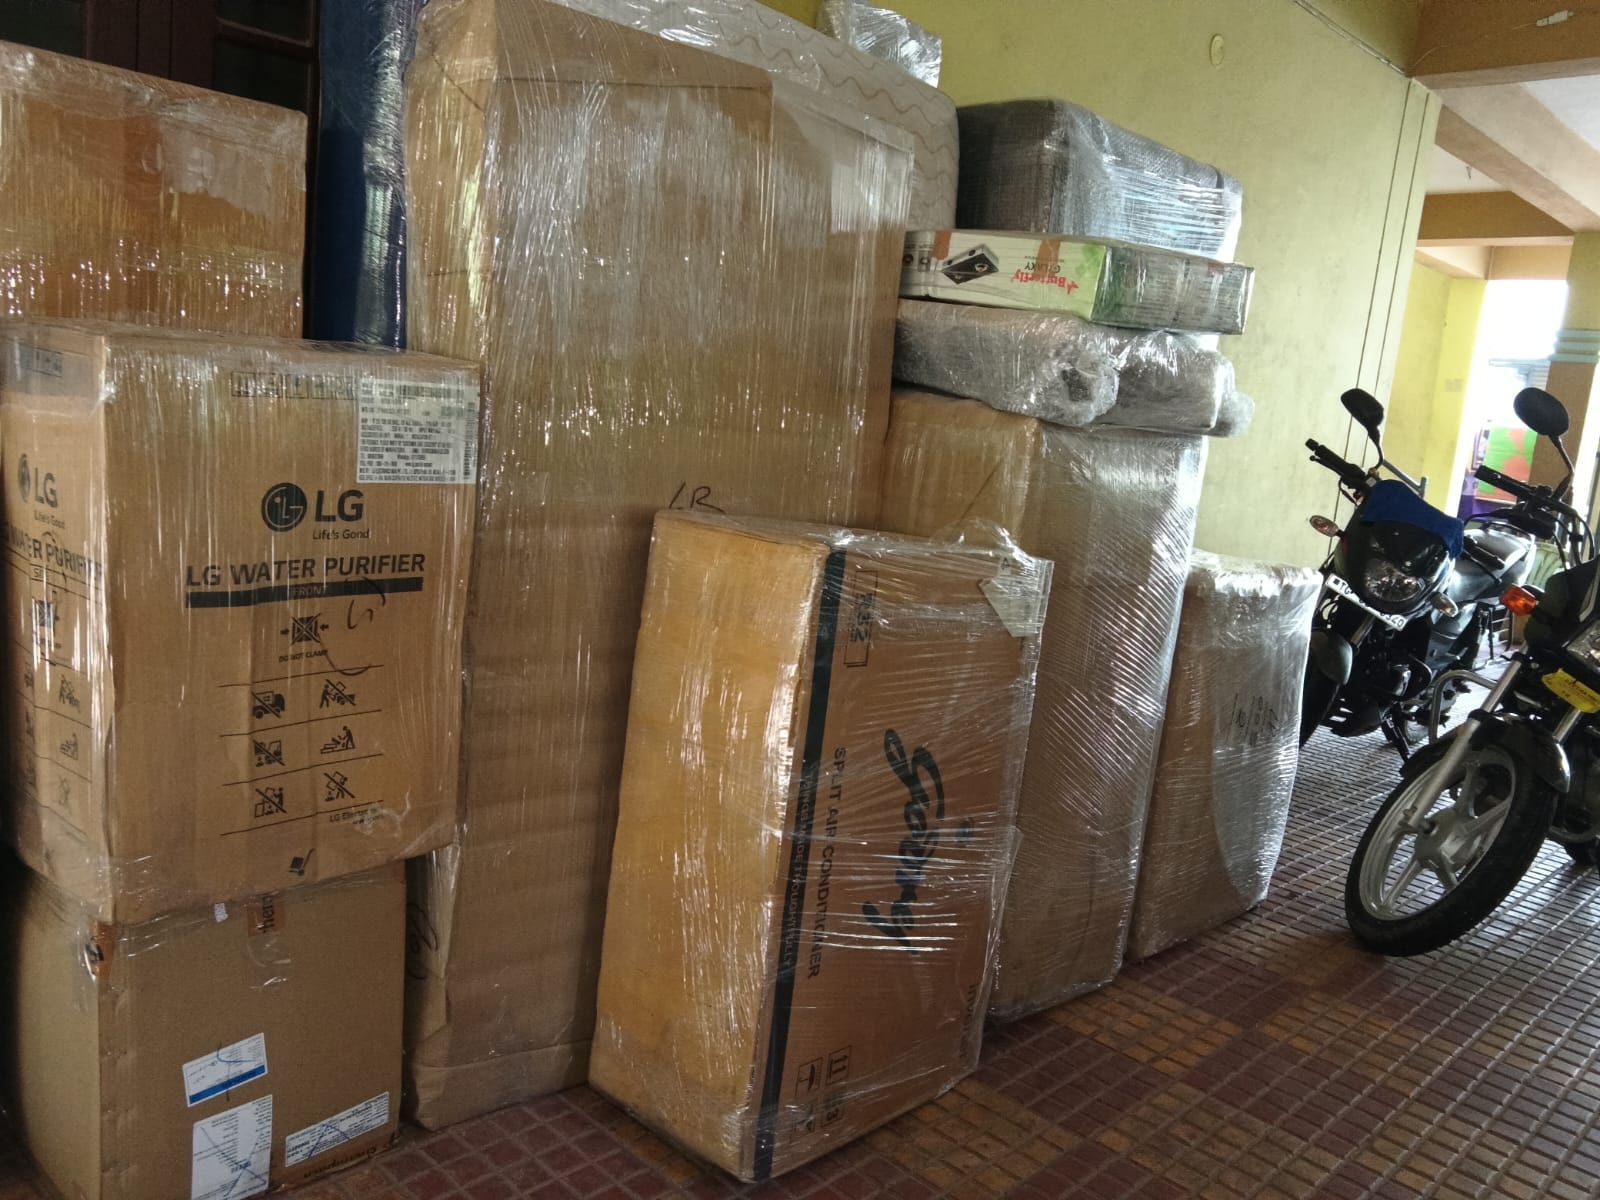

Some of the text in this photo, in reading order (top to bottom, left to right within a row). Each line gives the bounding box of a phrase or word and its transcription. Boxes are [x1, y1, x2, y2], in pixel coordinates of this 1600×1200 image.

[1014, 269, 1067, 288] Butterfly
[35, 466, 58, 508] LG
[315, 489, 364, 522] LG
[312, 528, 370, 541] Life's Good
[46, 538, 103, 579] PURIF
[186, 553, 426, 587] LG WATER PURIFIER
[293, 584, 329, 599] FRONT
[278, 655, 289, 663] DO
[305, 649, 328, 660] CLAMP
[808, 747, 848, 980] SPLIT AIR CONDITIONER
